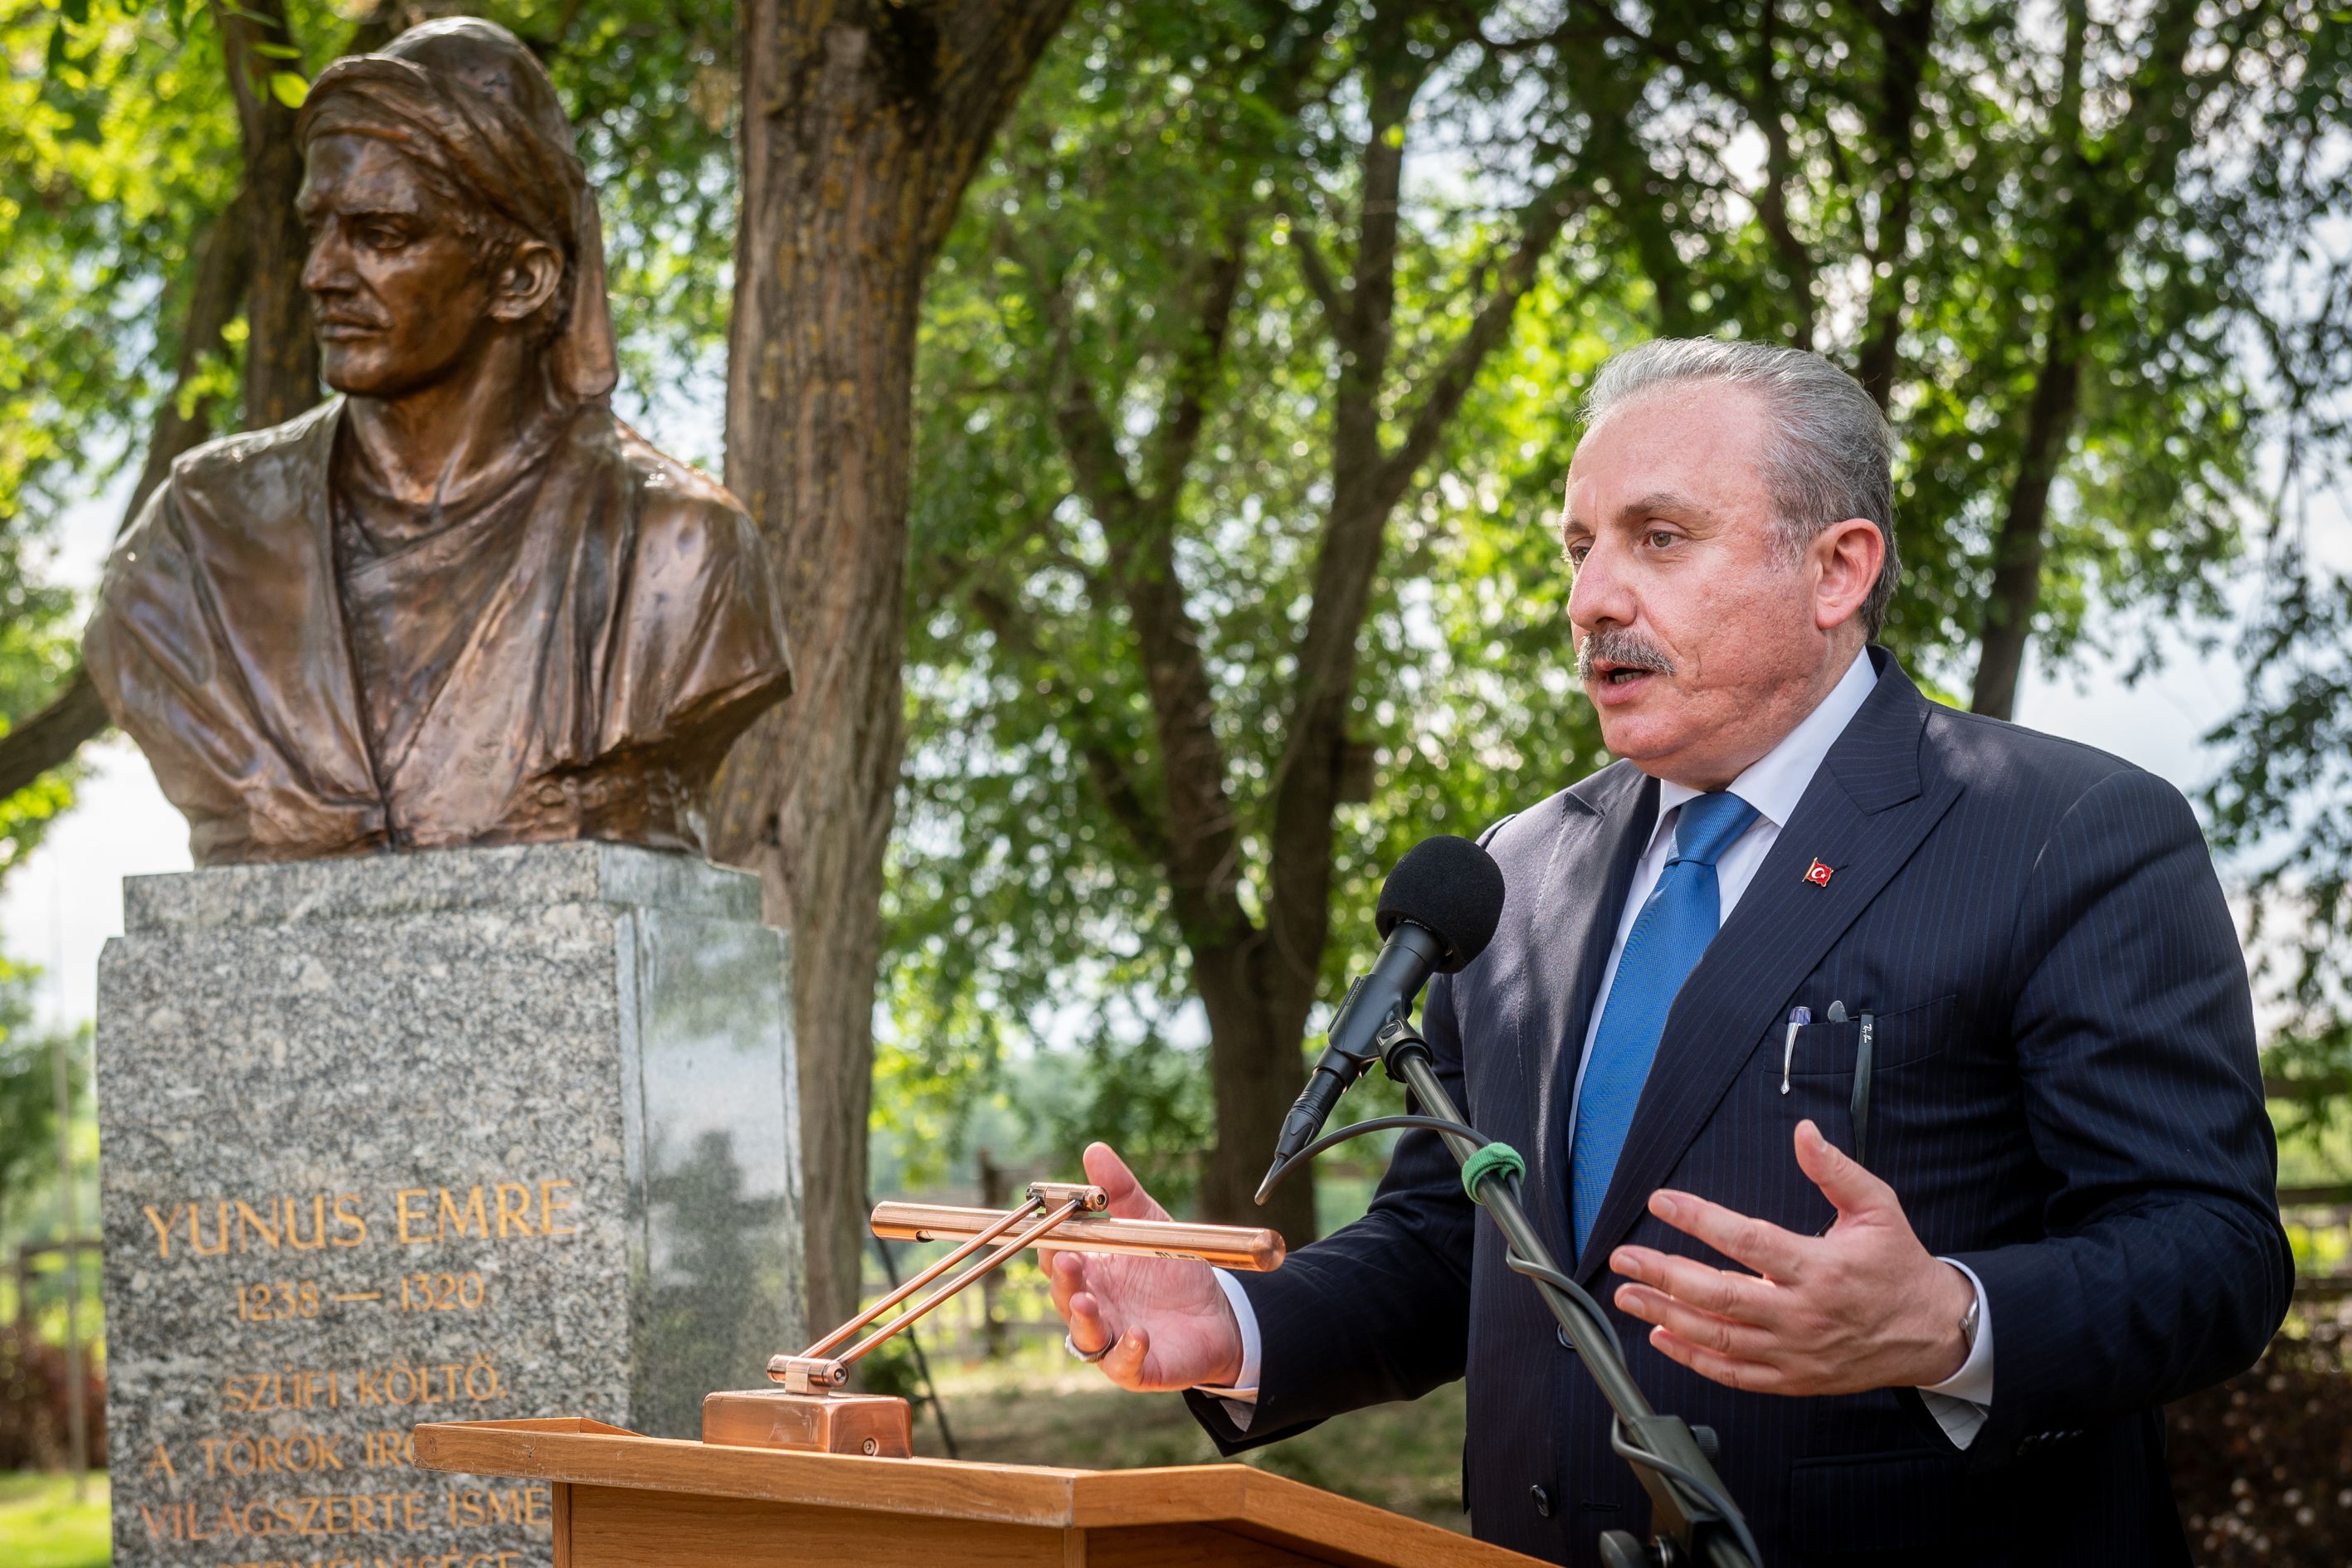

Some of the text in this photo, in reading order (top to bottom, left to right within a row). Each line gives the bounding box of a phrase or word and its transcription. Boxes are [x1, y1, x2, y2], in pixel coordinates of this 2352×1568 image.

[143, 1180, 576, 1259] YUNUS EMRE
[238, 1280, 319, 1322] 1238
[401, 1270, 485, 1312] 1320
[144, 1442, 179, 1480] A
[197, 1426, 345, 1476] TÖRÖK
[140, 1490, 429, 1541] VILÁGSZERTE
